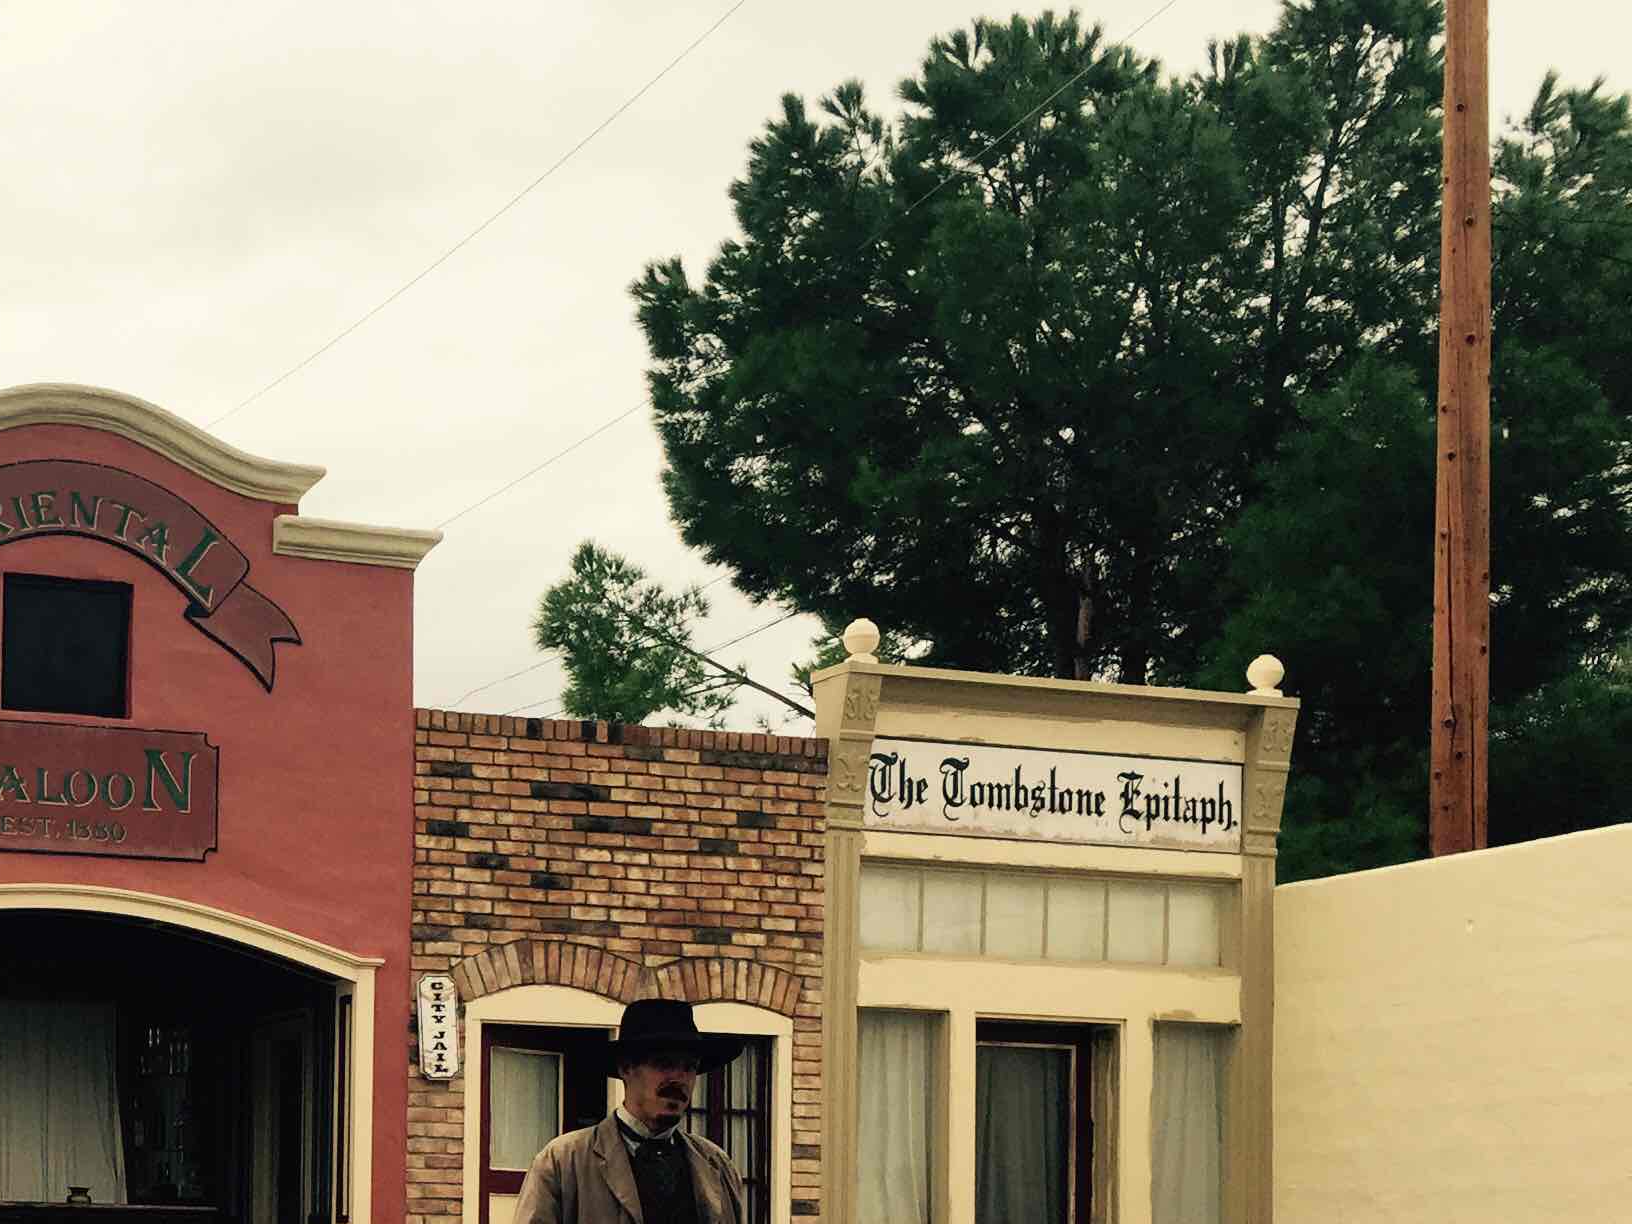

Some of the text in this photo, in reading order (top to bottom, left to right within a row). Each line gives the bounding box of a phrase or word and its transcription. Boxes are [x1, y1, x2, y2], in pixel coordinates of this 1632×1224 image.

[0, 815, 60, 840] EST.
[868, 751, 1239, 835] The Tombstone Epitaph.
[430, 981, 449, 1073] CITY JAIL
